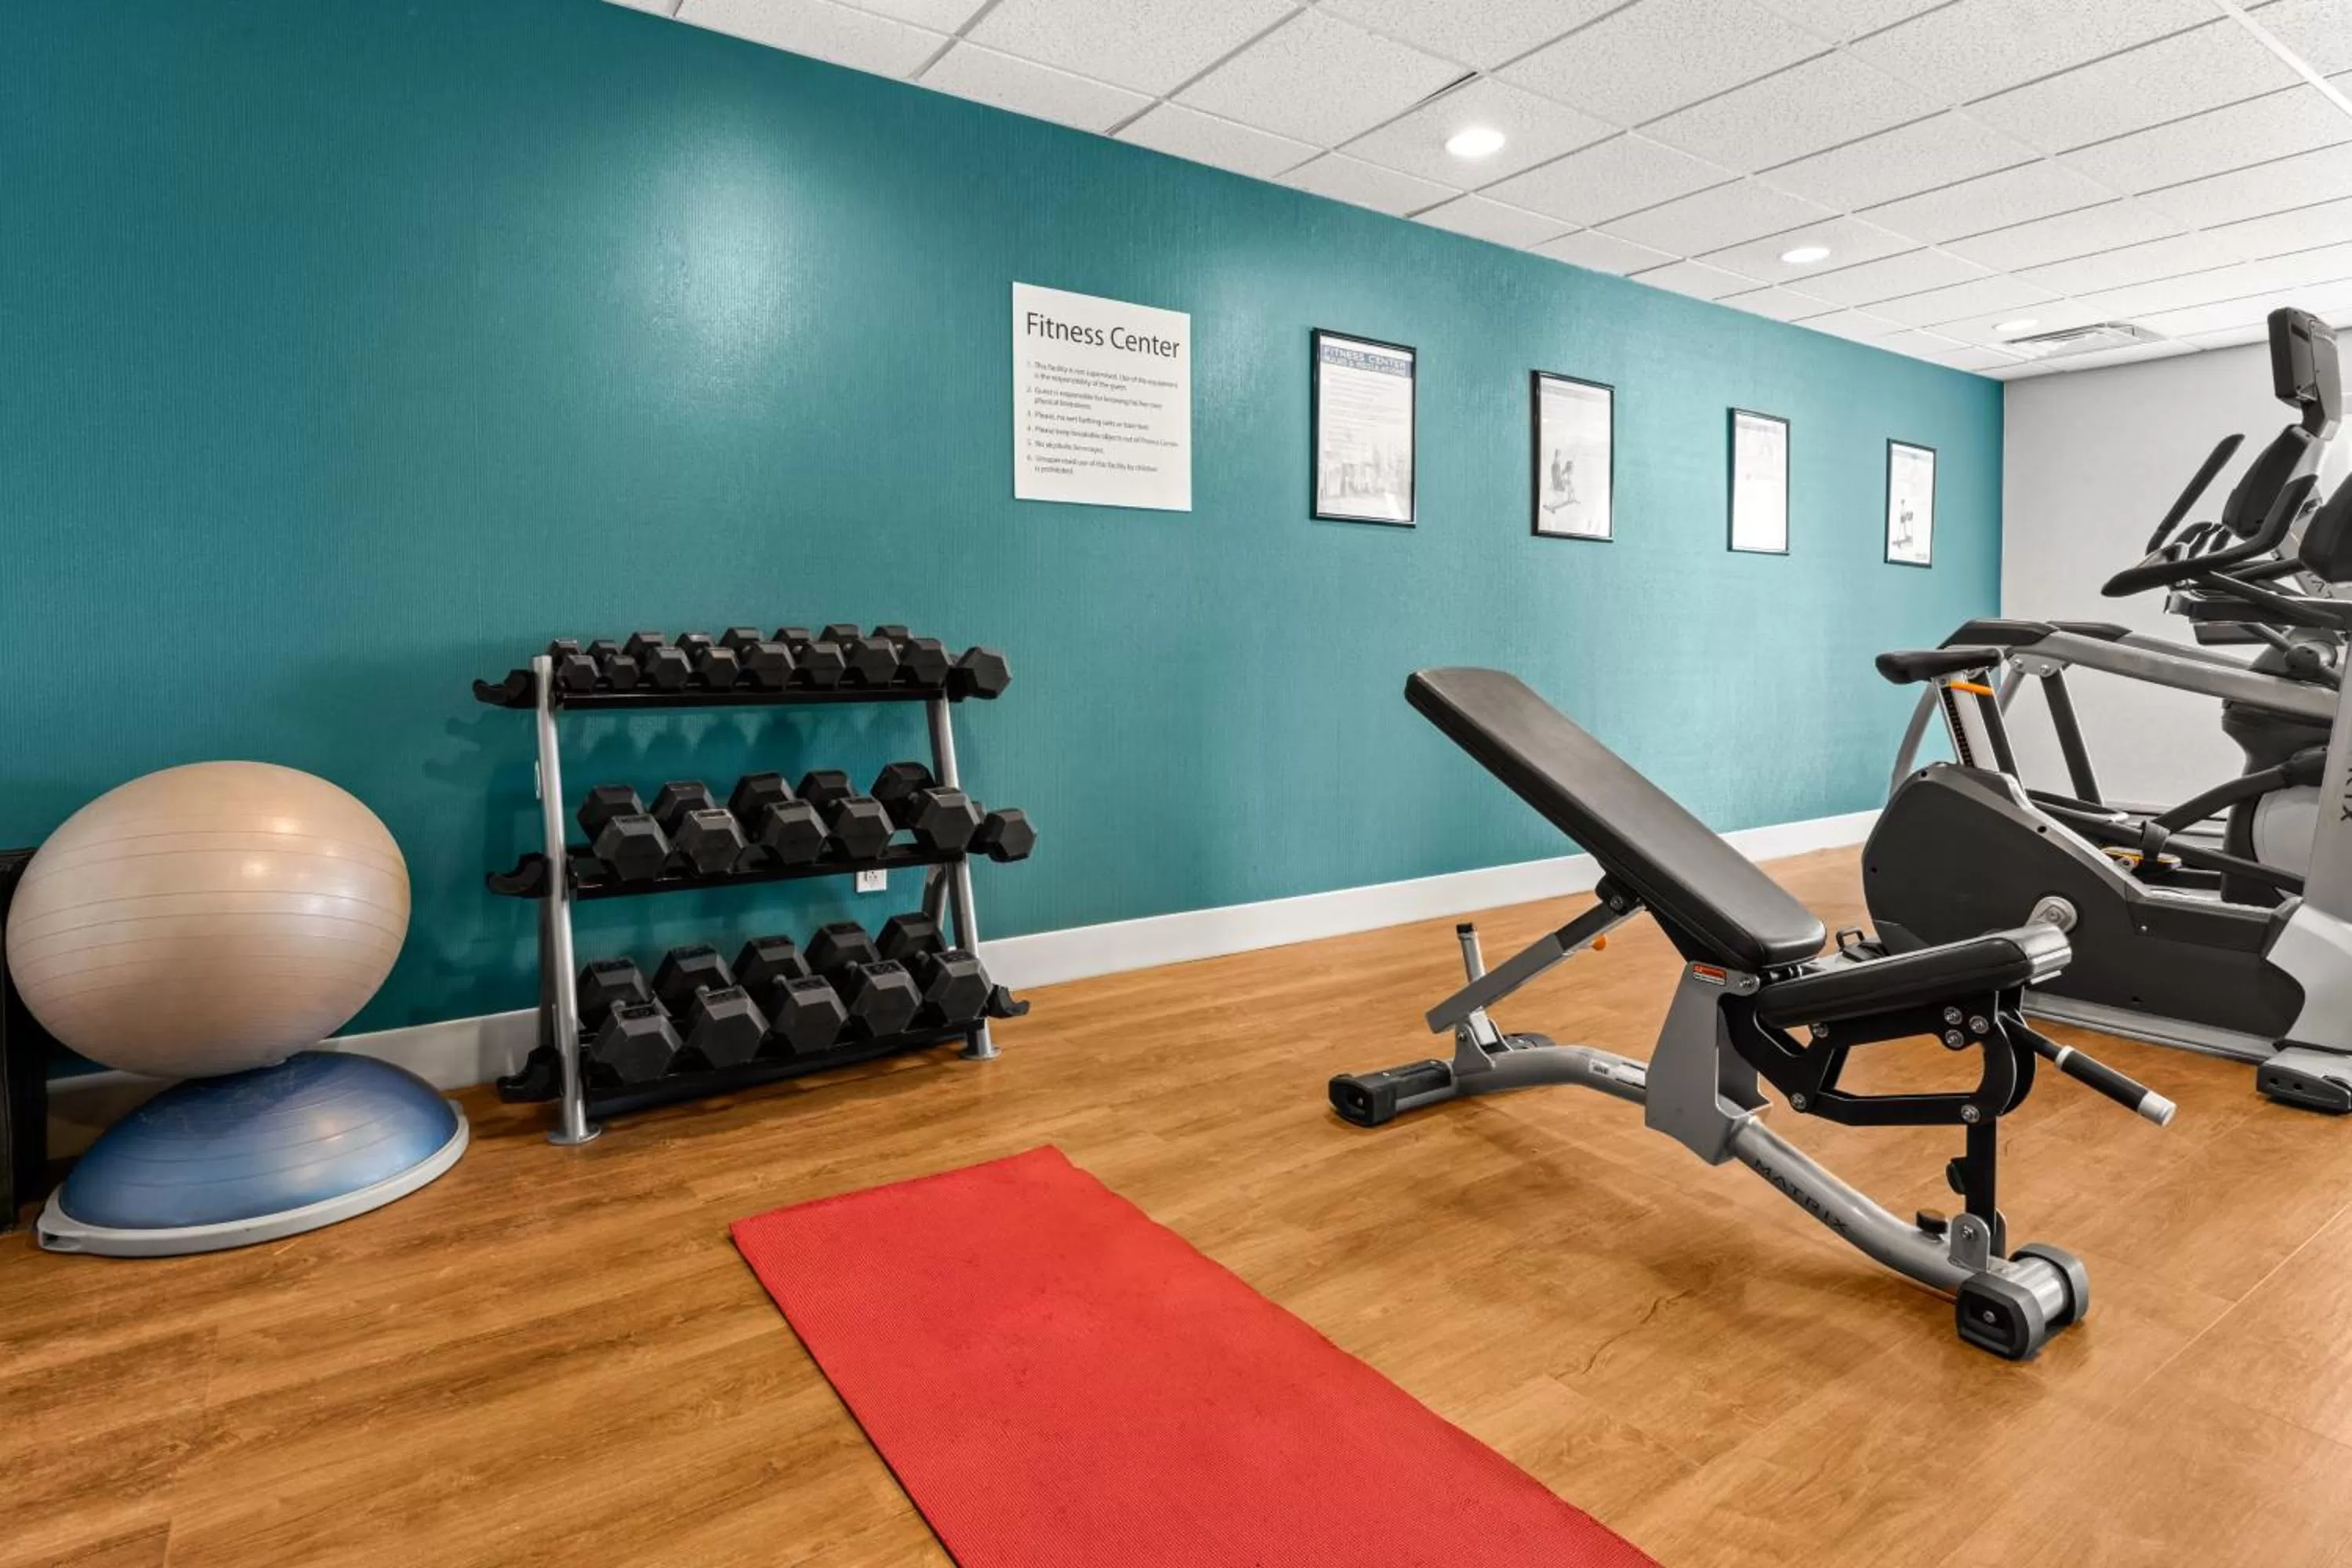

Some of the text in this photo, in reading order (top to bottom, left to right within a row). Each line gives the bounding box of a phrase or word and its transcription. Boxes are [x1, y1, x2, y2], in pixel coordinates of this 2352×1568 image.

[1027, 311, 1180, 358] Fitness Center
[1755, 1158, 1848, 1233] MATRIX
